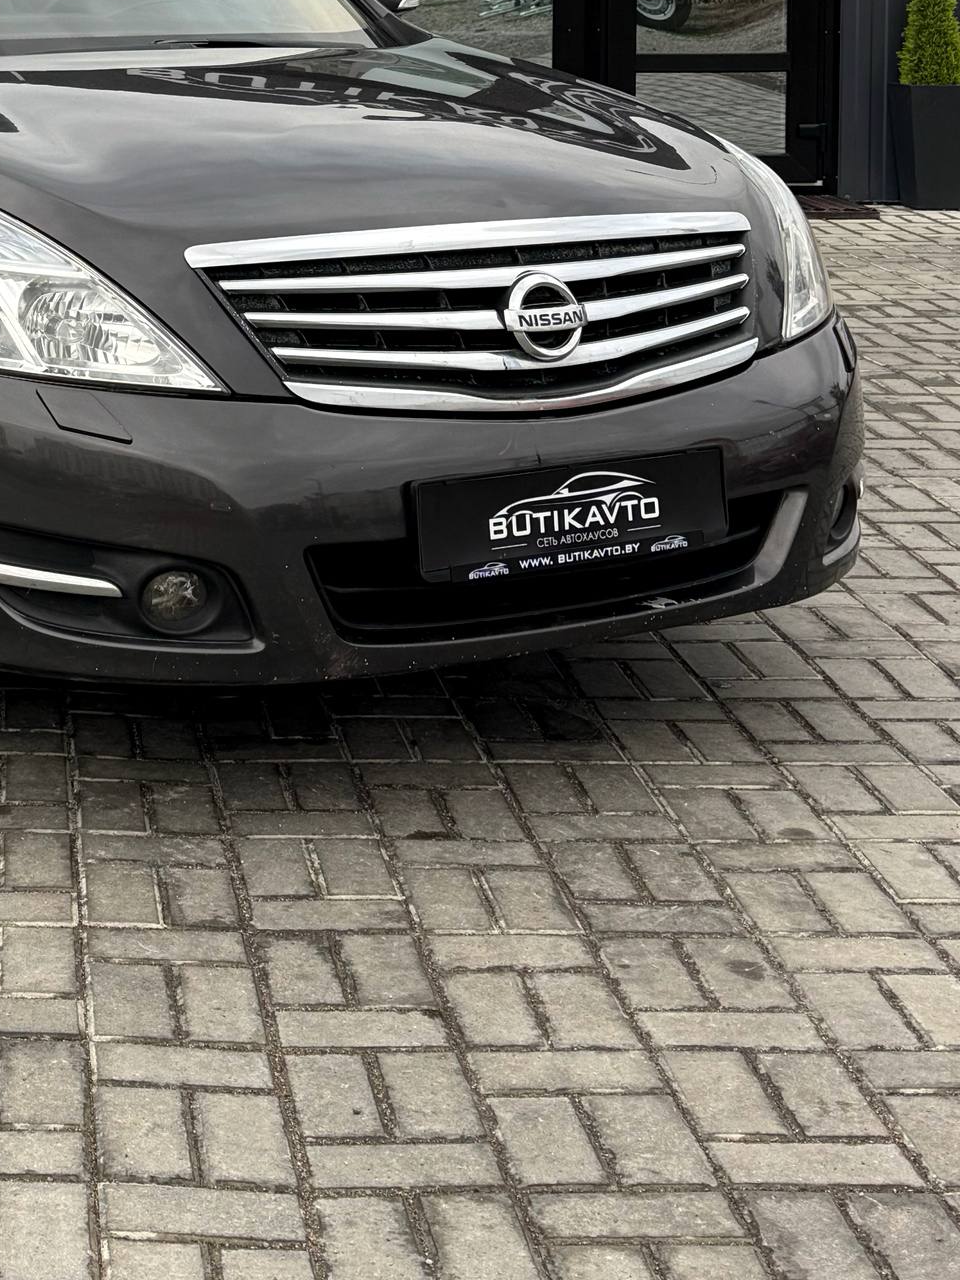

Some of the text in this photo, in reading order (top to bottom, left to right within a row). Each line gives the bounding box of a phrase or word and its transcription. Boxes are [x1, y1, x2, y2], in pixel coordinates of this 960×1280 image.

[518, 309, 583, 327] NISSAN
[489, 496, 660, 541] BUTIKAVTO
[536, 528, 619, 548] СЕТЬ АВТОХАУСОВ
[651, 539, 688, 552] BUTIKAVTO
[519, 543, 640, 569] WWW. BUTIKAVTO.BY
[468, 567, 509, 580] BUTIKAVTO
